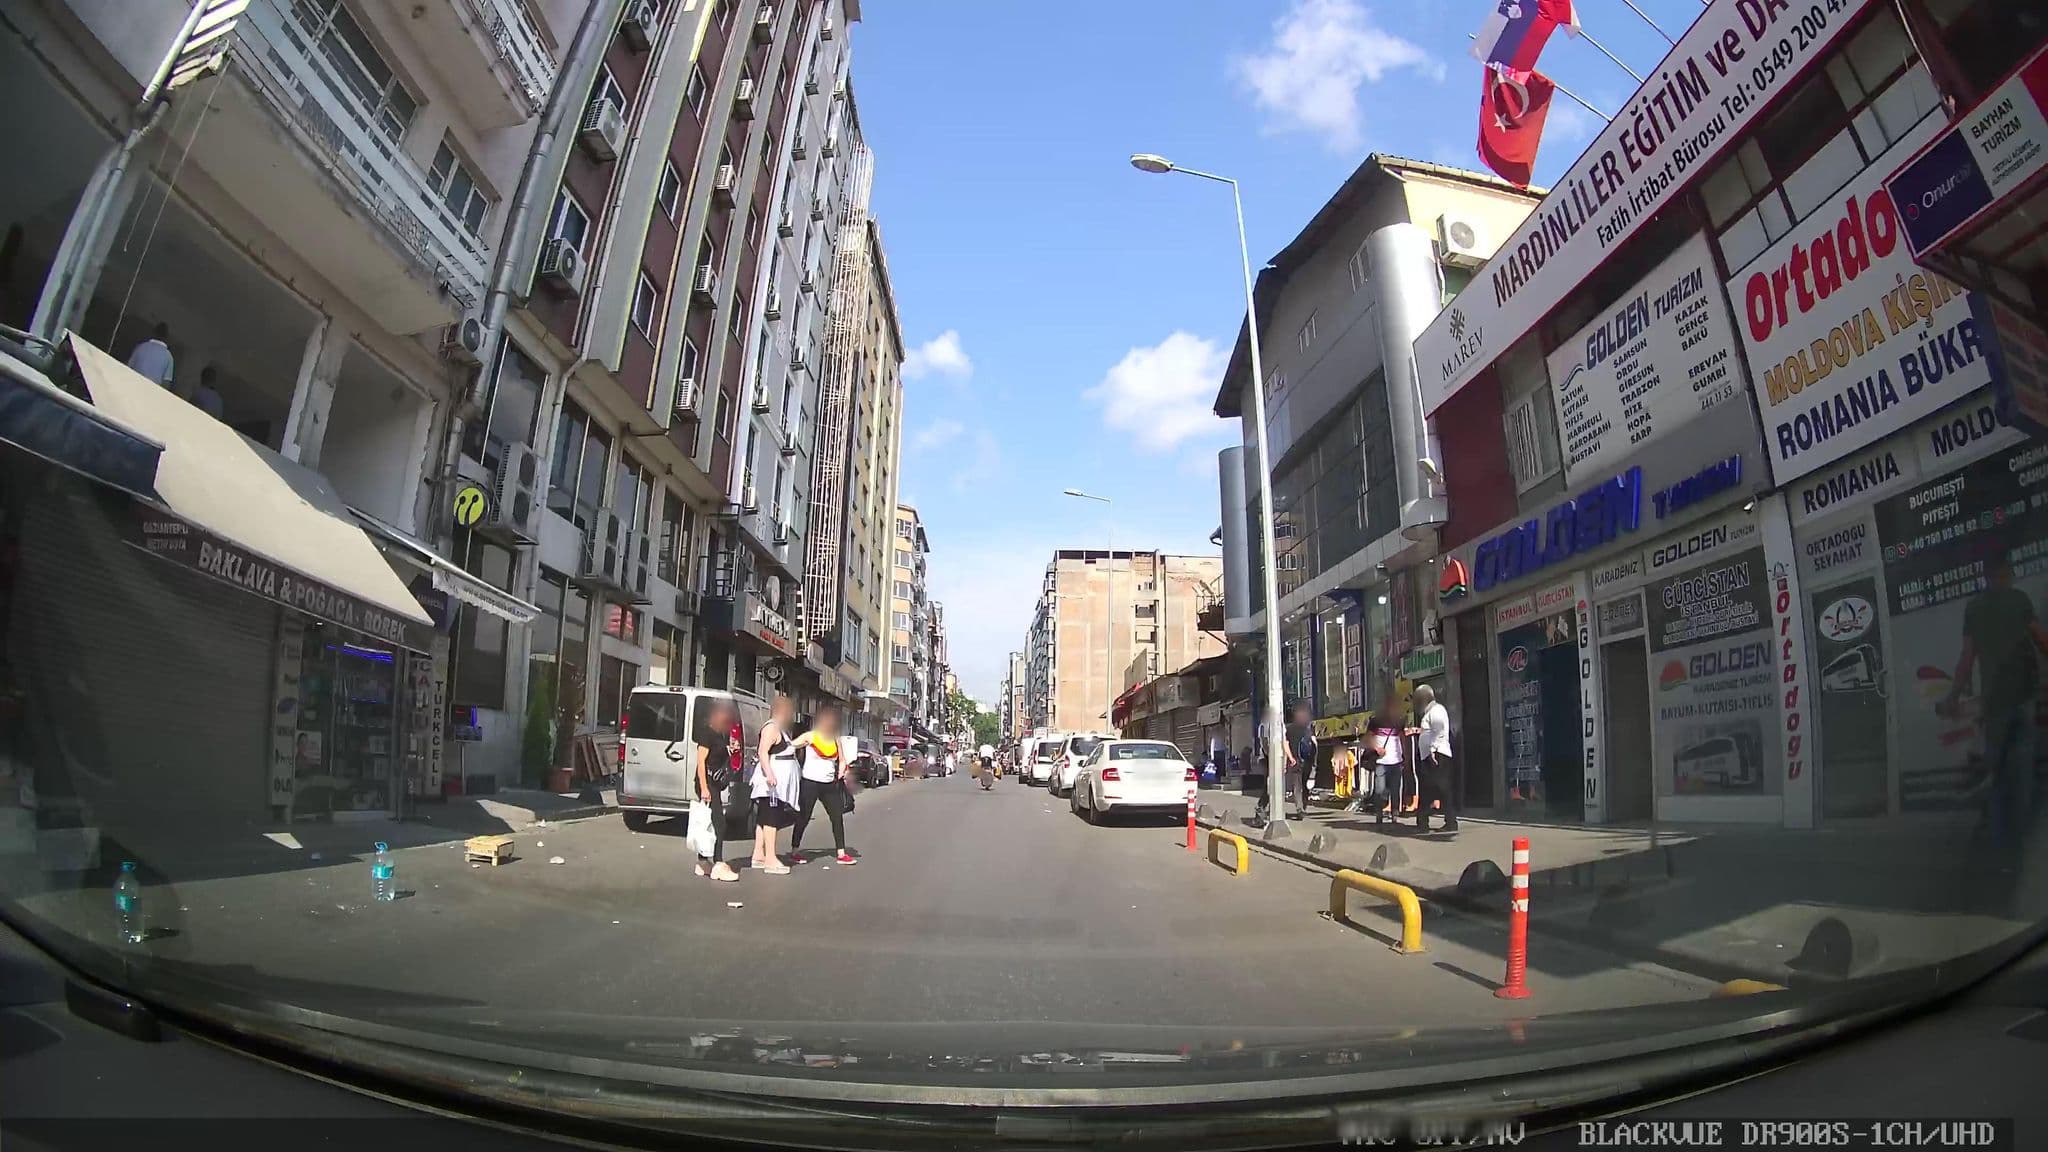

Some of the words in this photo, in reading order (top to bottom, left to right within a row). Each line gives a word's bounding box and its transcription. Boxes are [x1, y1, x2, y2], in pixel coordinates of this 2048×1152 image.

[1596, 205, 1631, 248] Fatih
[1627, 163, 1676, 218] İrtibat
[1672, 113, 1727, 173] Bürosu
[1720, 84, 1755, 122] Tel:
[1752, 38, 1794, 92] 0549
[1791, 5, 1828, 51] 200
[1971, 98, 2014, 140] BAYHAN
[1981, 116, 2023, 155] TURİZM
[1492, 150, 1625, 308] MARDİNLİLER
[1619, 57, 1711, 174] EĞİTİM
[1705, 28, 1746, 77] ve
[1586, 291, 1650, 370] GOLDEN
[1653, 267, 1703, 320] TURİZM
[1675, 295, 1709, 324] KAZAK
[1678, 311, 1709, 337] GENCE
[1441, 327, 1484, 381] MAREV
[1613, 338, 1648, 368] SAMSUN
[1681, 326, 1709, 351] BAKÜ
[1616, 359, 1640, 381] ORDU
[1688, 349, 1727, 379] EREVAN
[1763, 307, 1886, 406] MOLDOVA
[1561, 385, 1584, 406] BATUM
[1618, 364, 1655, 393] GİRESUN
[1621, 375, 1661, 406] TRABZON
[1692, 364, 1727, 392] GUMRİ
[1724, 386, 1734, 400] 53
[1627, 412, 1652, 432] HOPA
[1776, 368, 1900, 460] ROMANIA
[1630, 426, 1652, 444] SARP
[1802, 452, 1900, 514] ROMANIA
[1653, 525, 1727, 568] GOLDEN
[1813, 543, 1863, 572] SEYAHAT
[198, 541, 275, 597] BAKLAVA
[280, 577, 292, 600] &
[1594, 561, 1639, 587] KARADENİZ
[1662, 561, 1750, 610] GÜRCİSTAN
[1689, 640, 1771, 680] GOLDEN
[1579, 627, 1597, 800] GOLDEN
[431, 681, 444, 787] TURKCELL
